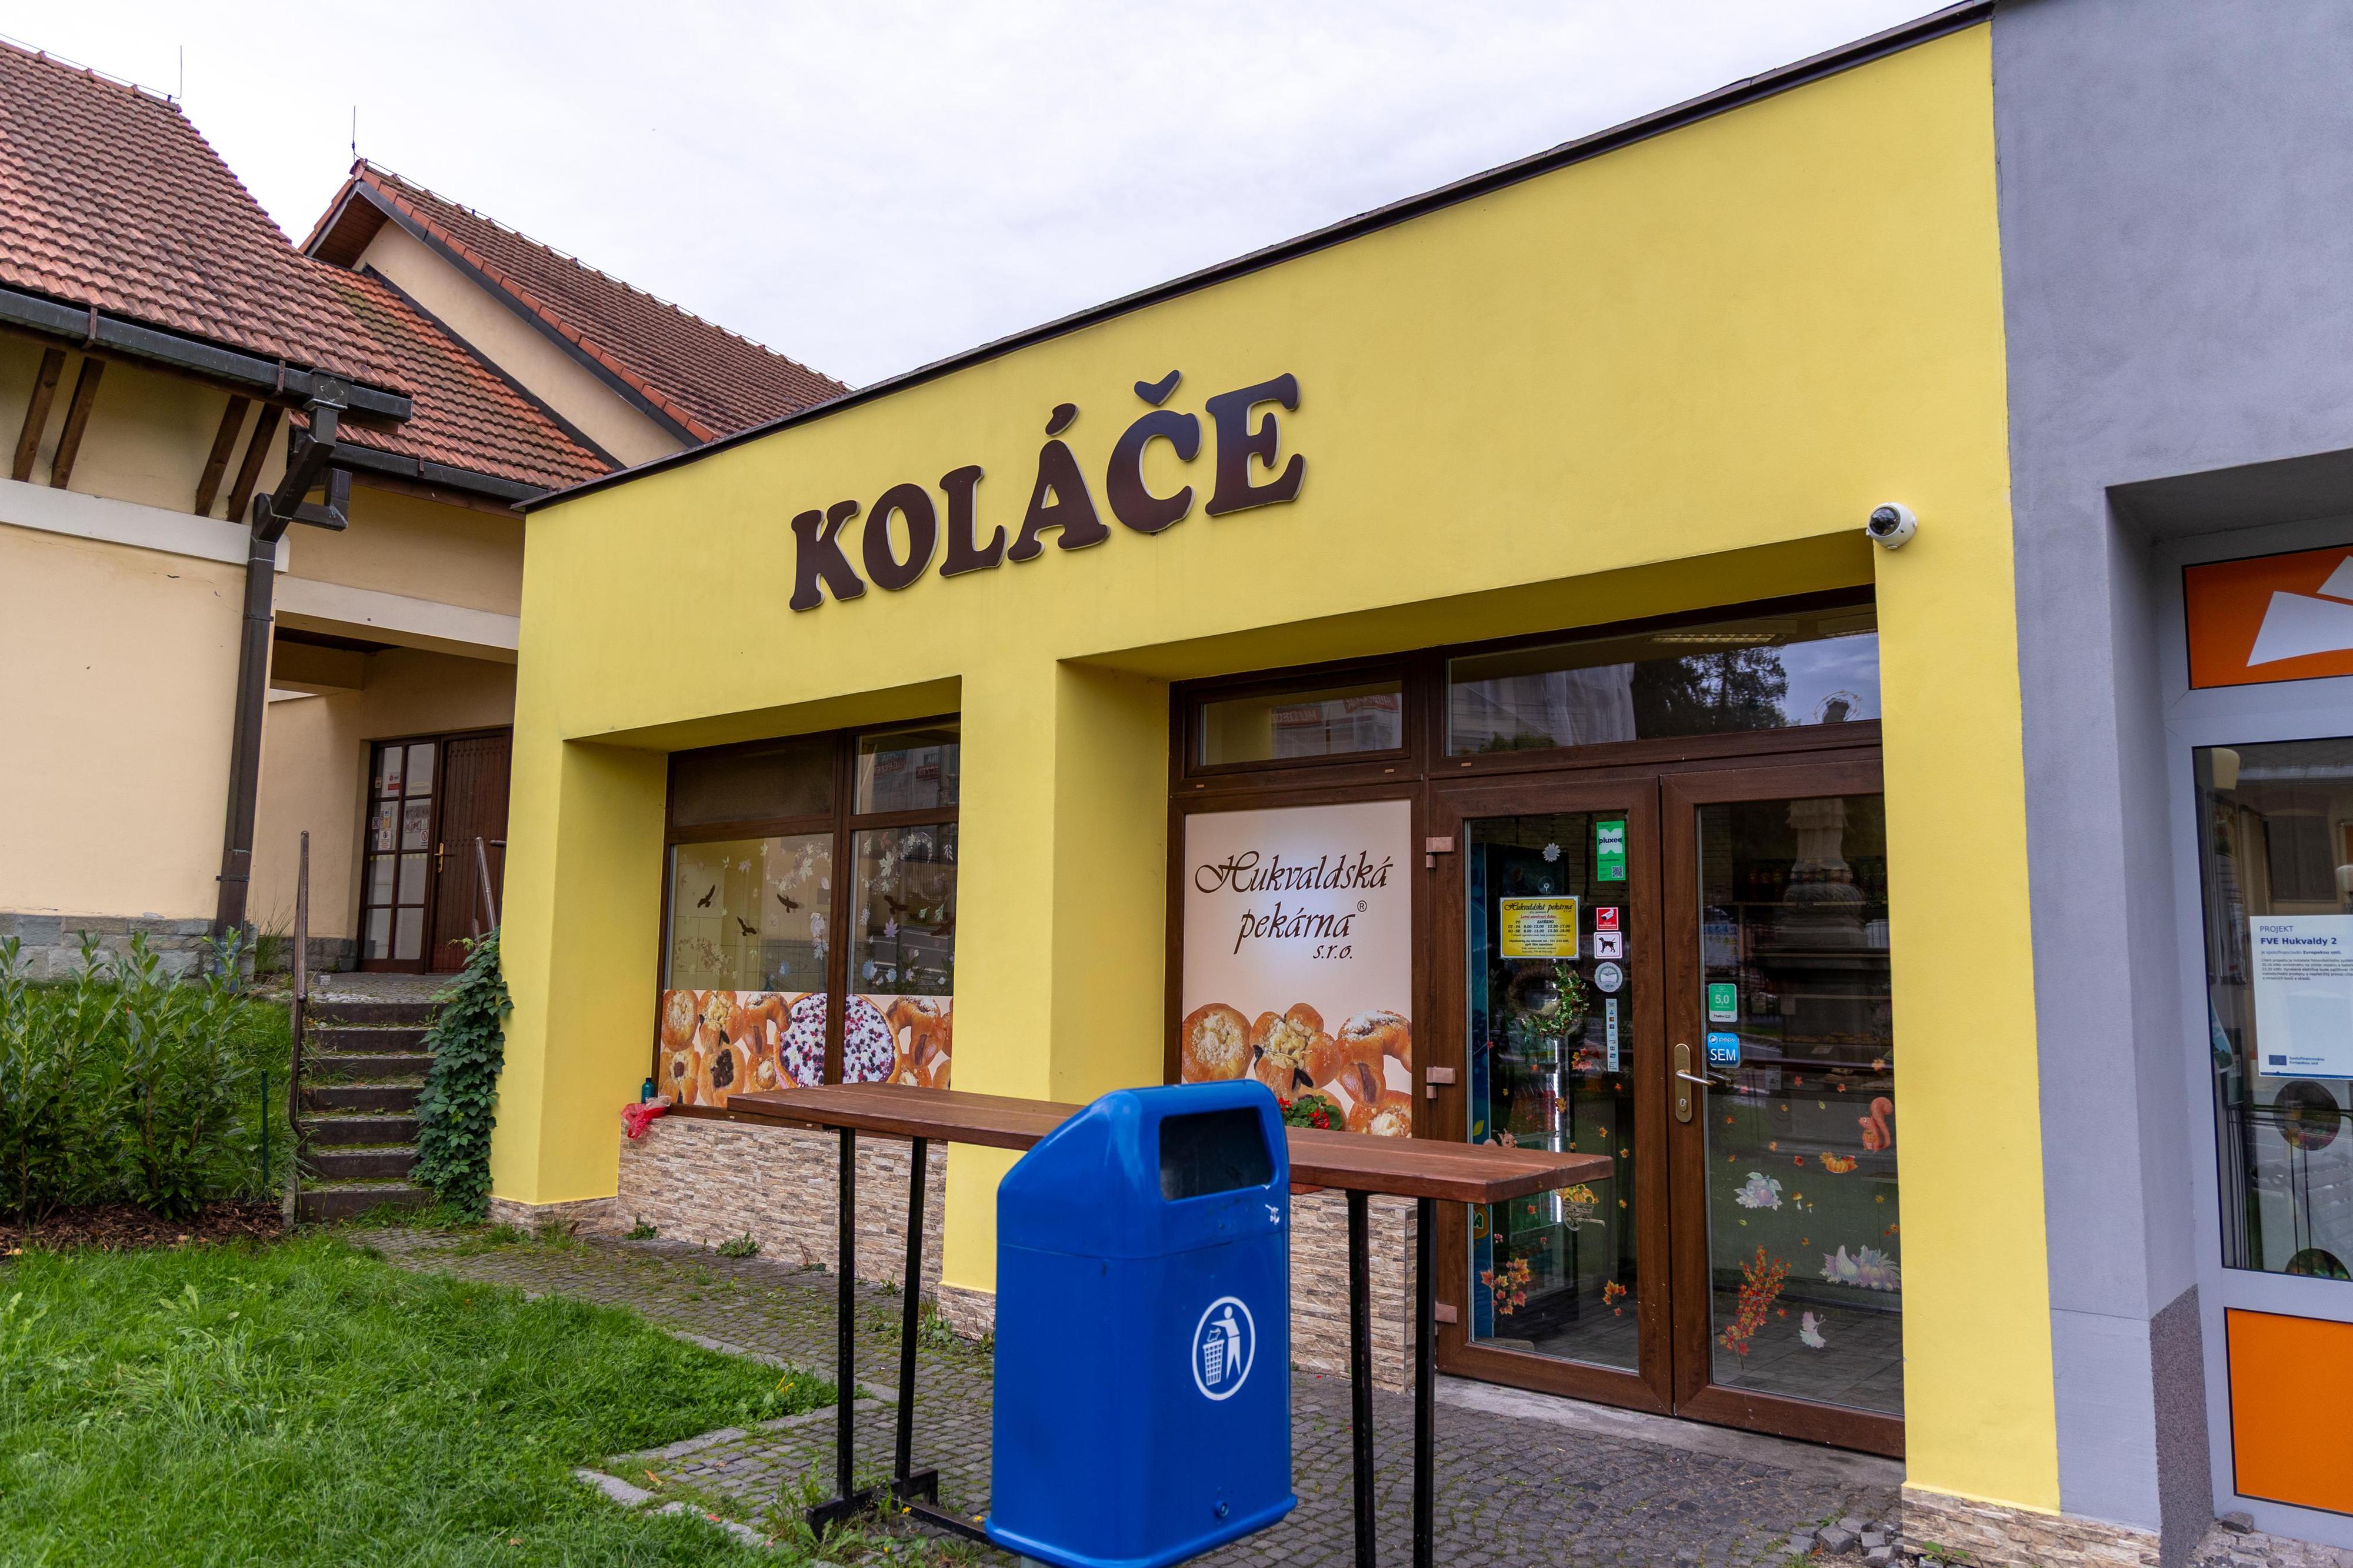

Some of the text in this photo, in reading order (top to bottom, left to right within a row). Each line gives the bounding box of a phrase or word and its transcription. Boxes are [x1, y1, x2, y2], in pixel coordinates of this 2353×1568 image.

[789, 369, 1308, 612] KOLÁČE
[1195, 850, 1394, 893] Hukvaldská
[2282, 938, 2328, 946] Hukvaldy
[1313, 942, 1353, 959] s.r.o.
[1715, 994, 1729, 1005] 5,0
[1710, 1048, 1736, 1061] SEM
